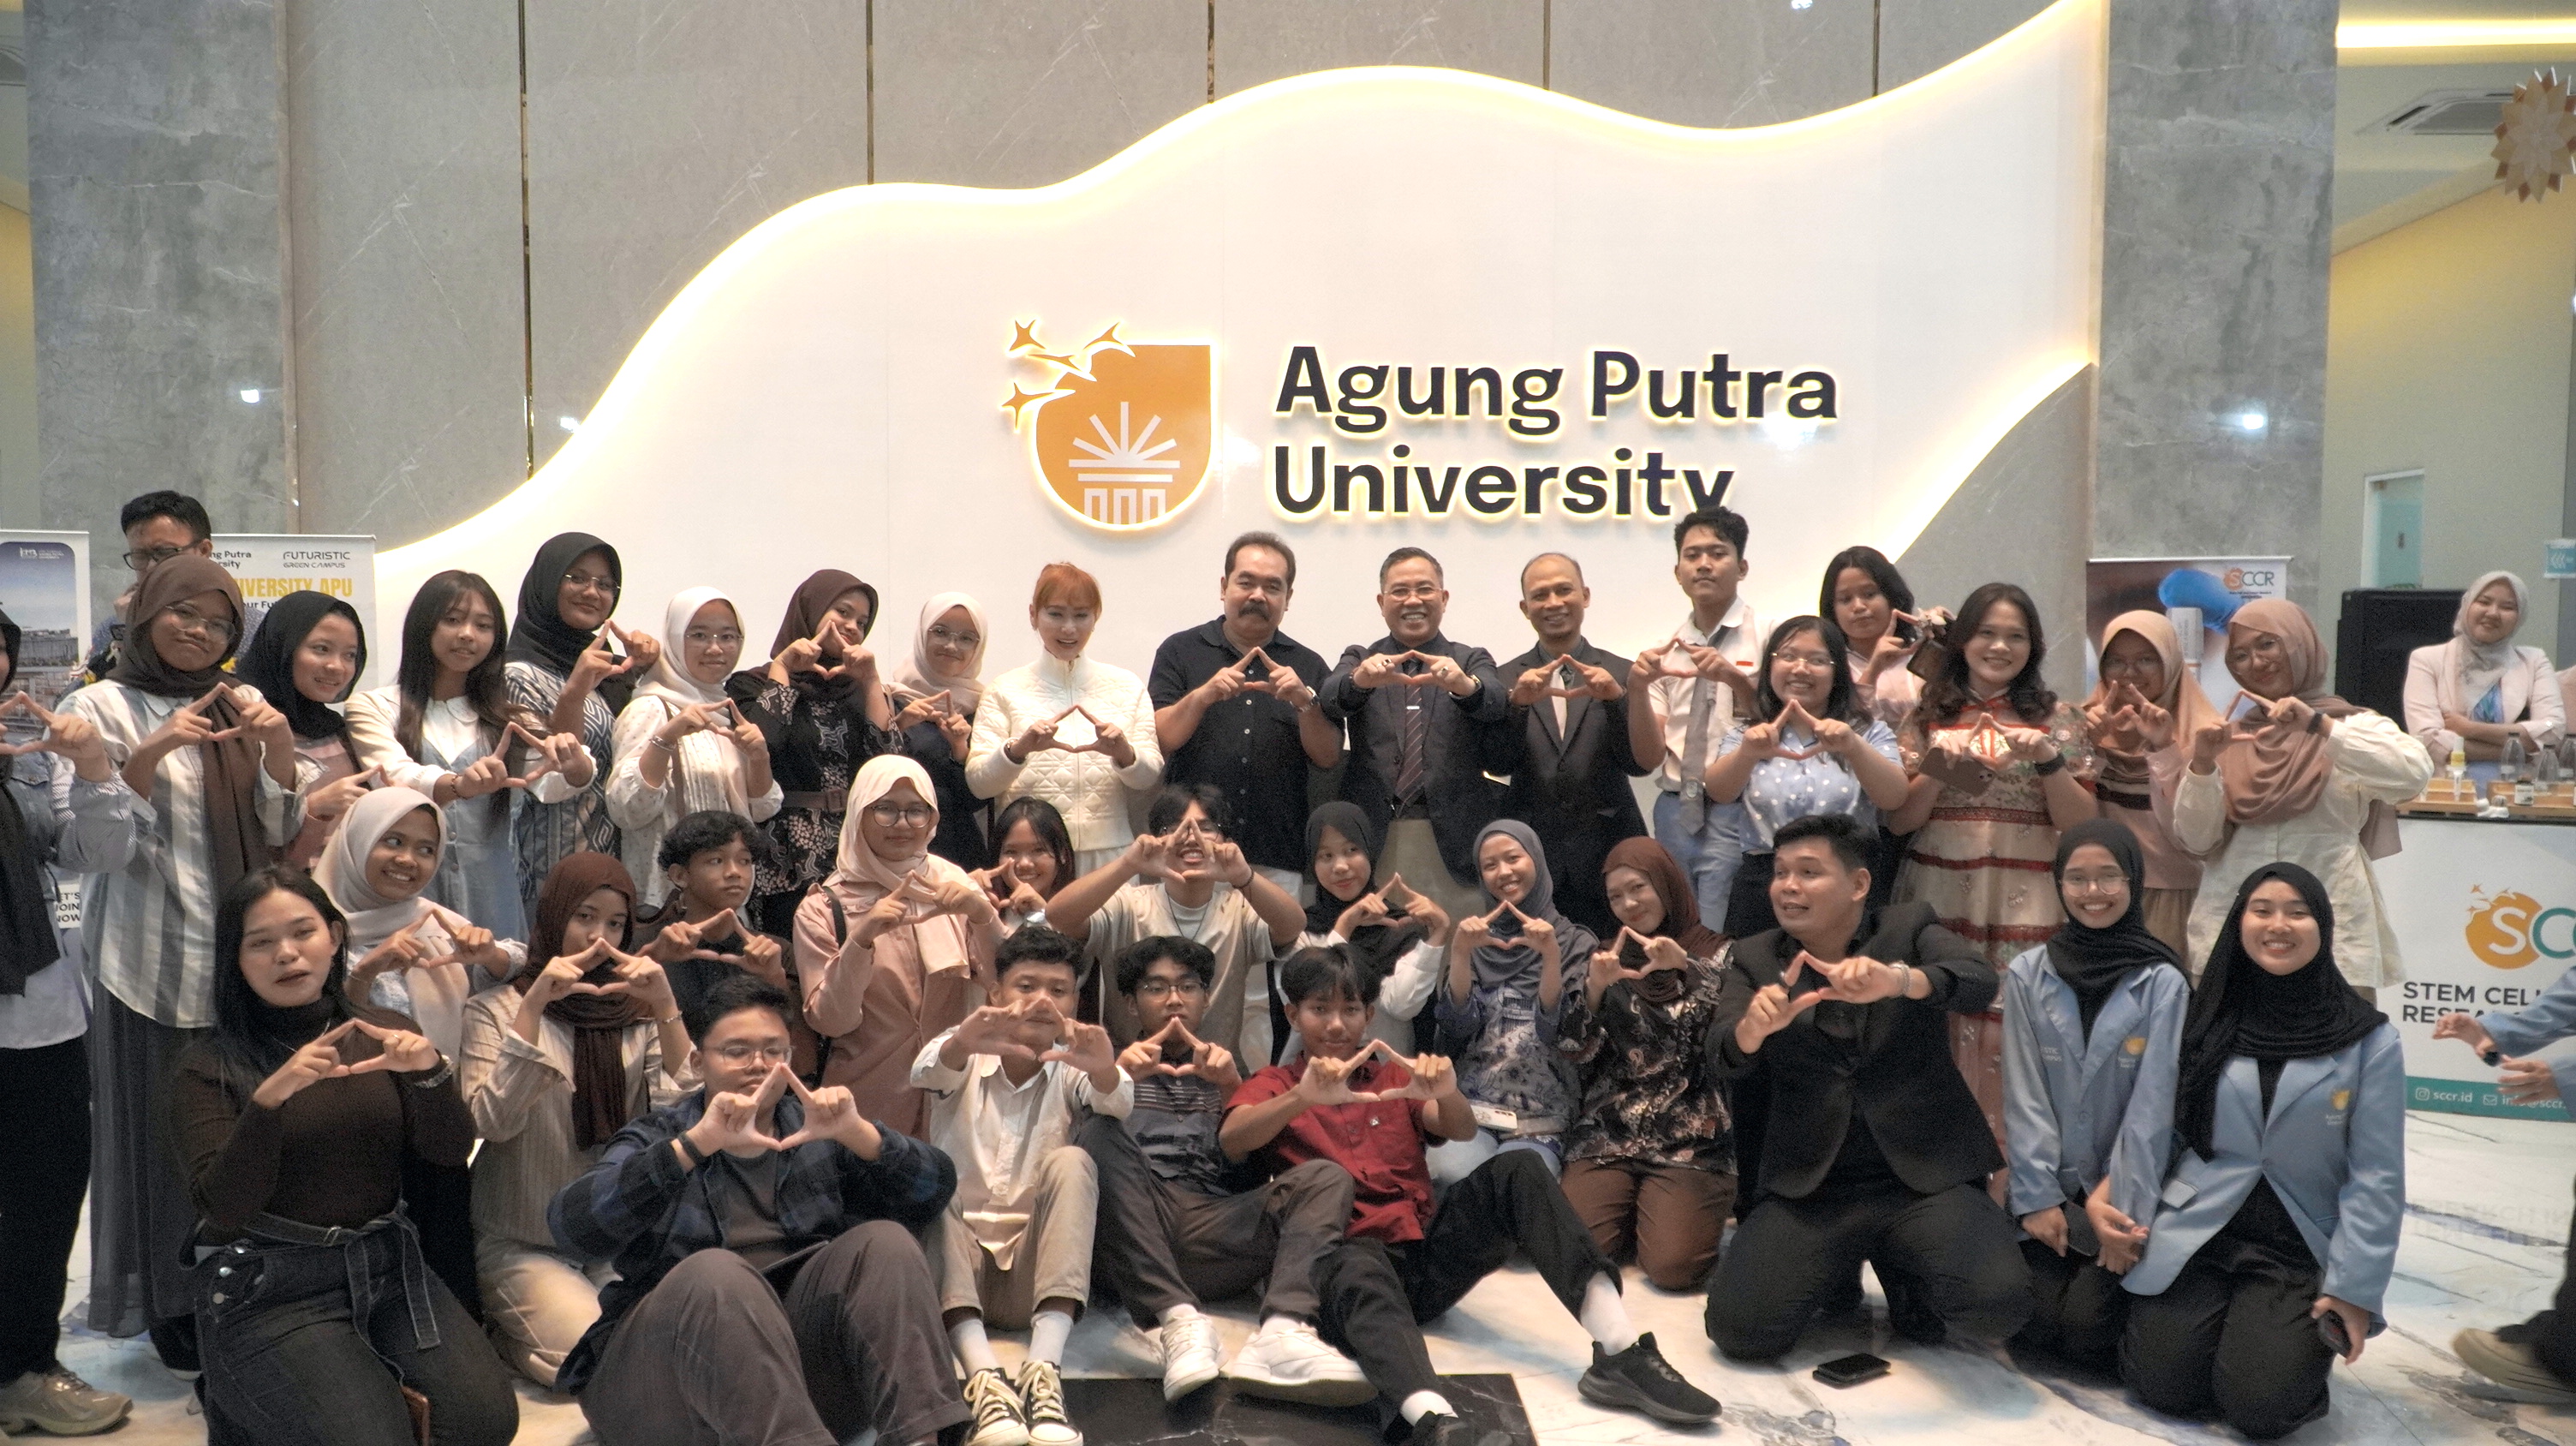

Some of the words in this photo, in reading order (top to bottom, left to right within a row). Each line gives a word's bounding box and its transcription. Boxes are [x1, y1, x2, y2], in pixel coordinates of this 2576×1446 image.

[1276, 346, 1564, 435] Agung
[1592, 350, 1837, 419] Putra
[1275, 444, 1735, 516] University
[283, 551, 350, 559] FUTURISTIC
[236, 577, 313, 598] IVERSITY
[320, 577, 353, 598] APU
[2489, 907, 2576, 959] SC
[2403, 981, 2475, 1003] STEM
[2433, 1092, 2473, 1102] sccr.id
